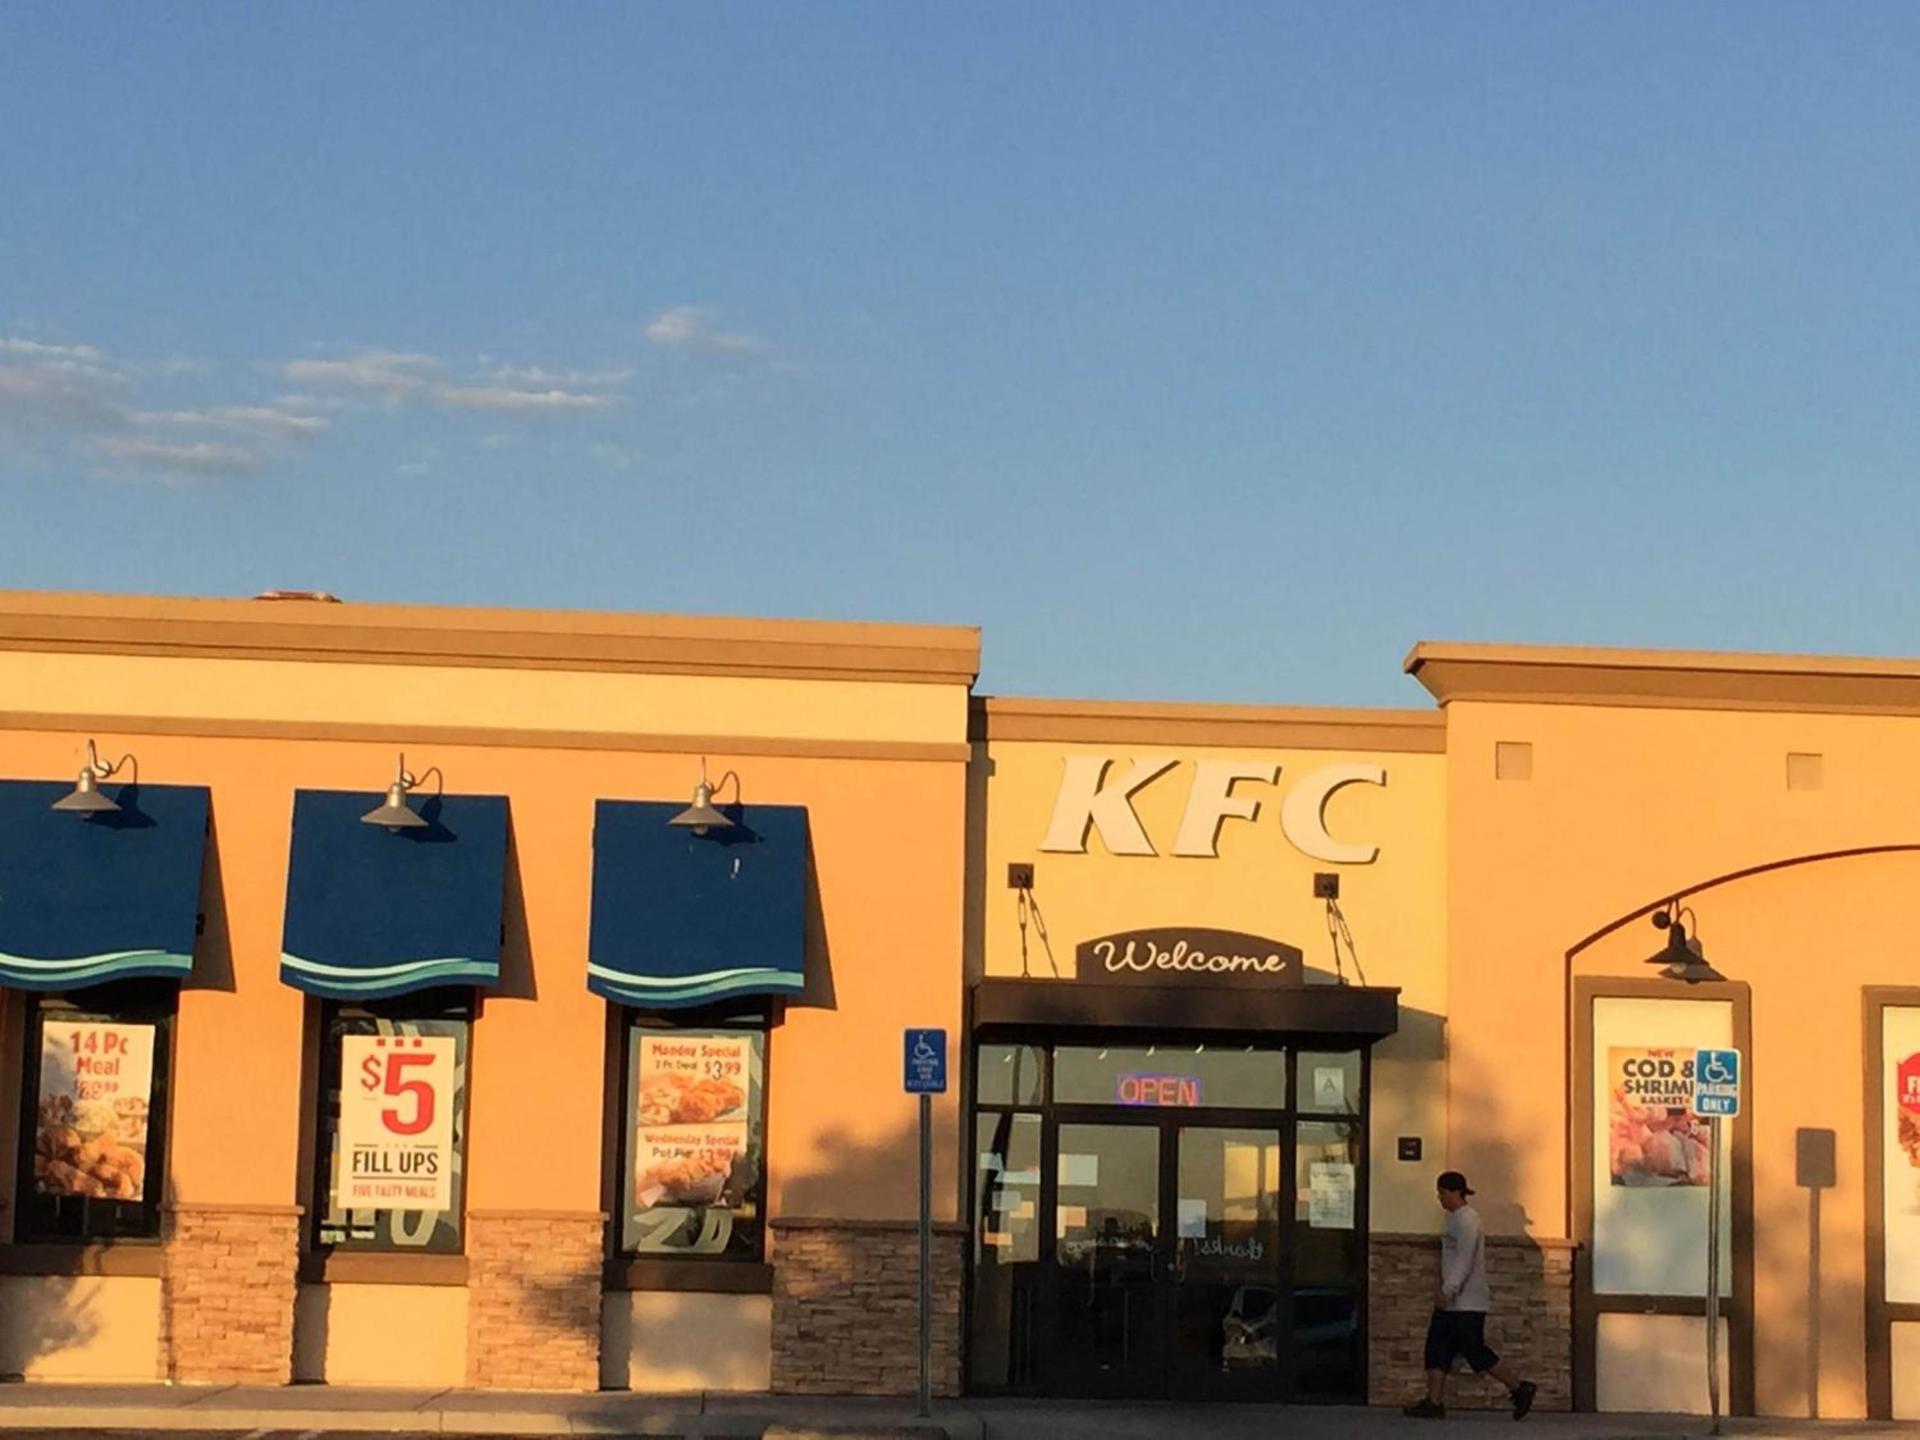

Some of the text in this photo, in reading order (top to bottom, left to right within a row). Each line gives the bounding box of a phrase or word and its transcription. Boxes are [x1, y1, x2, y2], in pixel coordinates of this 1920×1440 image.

[1038, 753, 1388, 865] KFC
[1092, 940, 1287, 974] Welcome
[69, 1030, 99, 1054] 14
[1622, 1059, 1675, 1078] COD
[359, 1053, 436, 1136] $5
[1119, 1077, 1197, 1106] OPEN
[352, 1151, 438, 1175] FILL UPS
